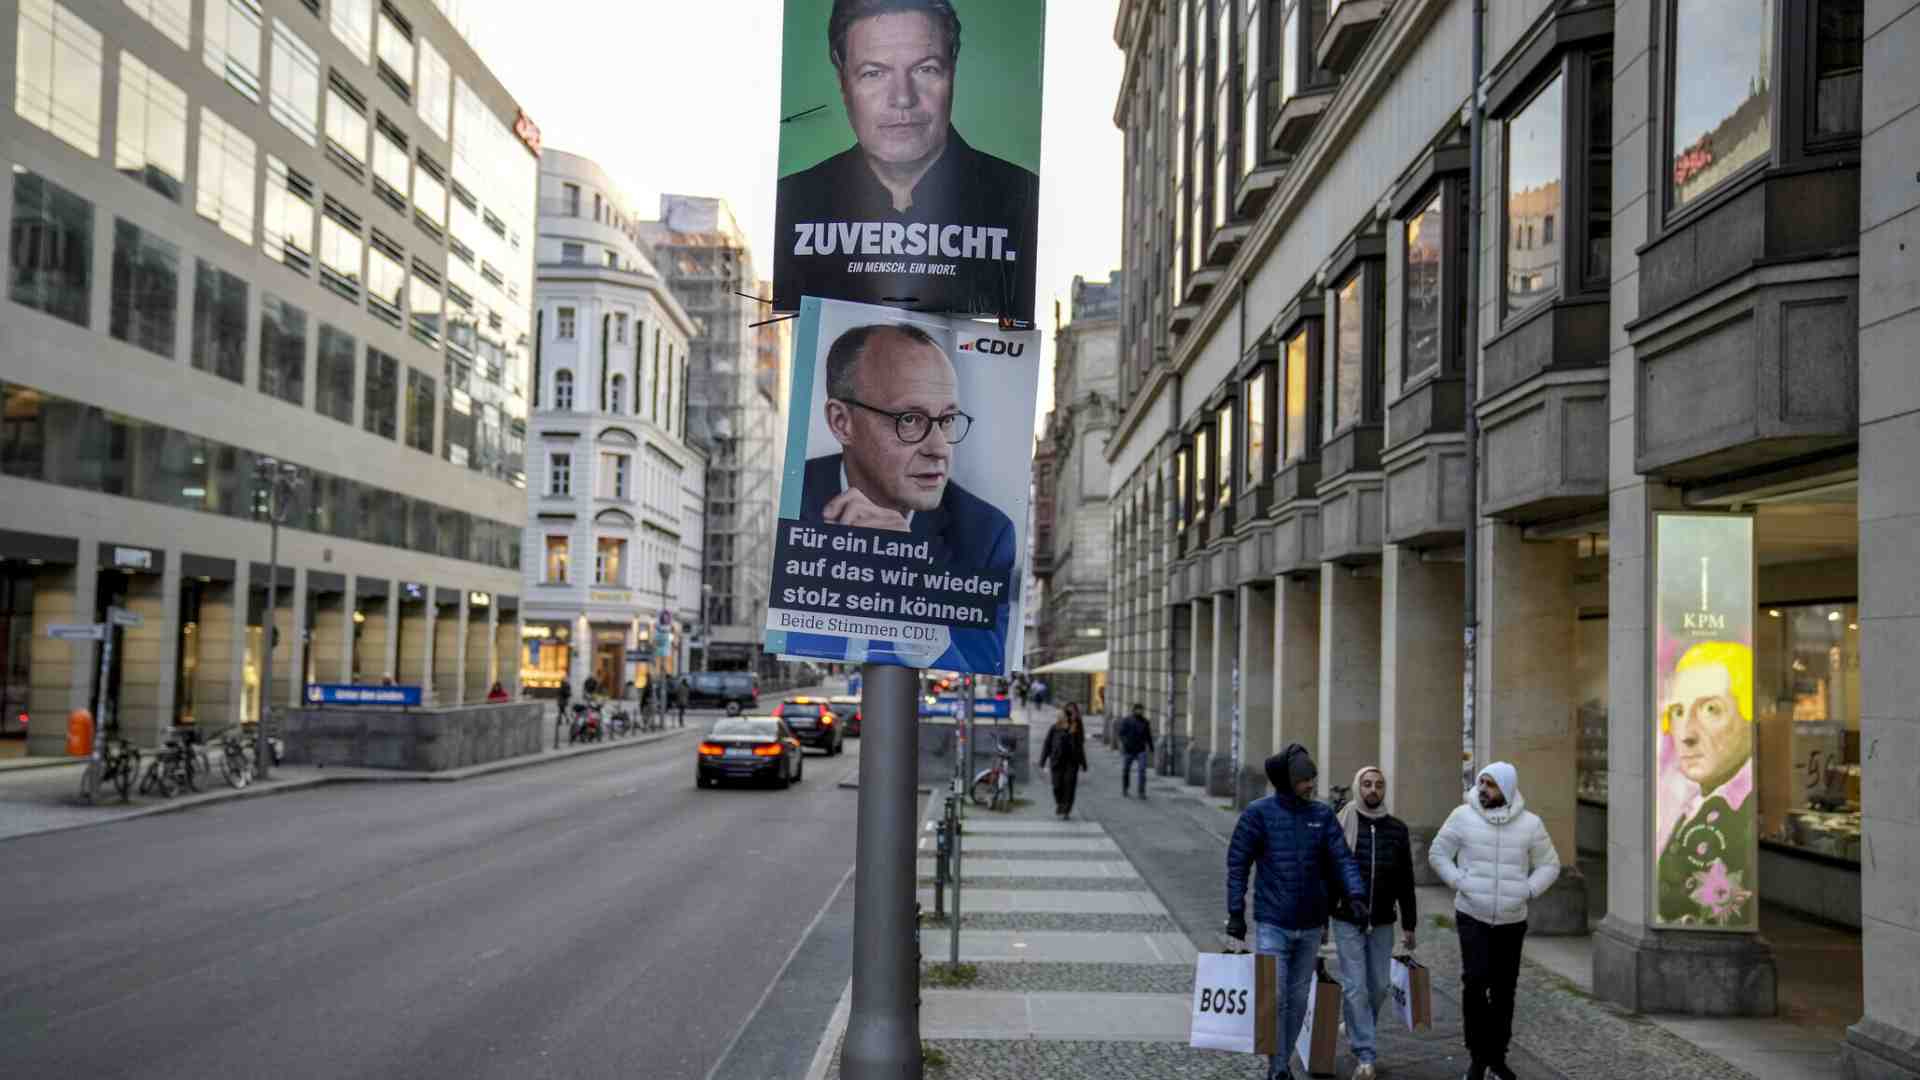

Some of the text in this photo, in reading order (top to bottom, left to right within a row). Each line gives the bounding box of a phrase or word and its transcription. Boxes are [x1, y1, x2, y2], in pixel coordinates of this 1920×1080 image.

[794, 222, 1016, 261] ZUVERSICHT.
[847, 262, 956, 276] EIN MENSCH. EIN WORT.
[975, 337, 1024, 357] CDU
[789, 526, 934, 565] Für ein Land,
[785, 558, 1003, 596] auf das wir wieder
[783, 586, 990, 623] stolz sein können.
[780, 612, 939, 642] Beide Stimmen CDU.
[1683, 612, 1725, 629] KPM
[1200, 987, 1248, 1015] BOSS
